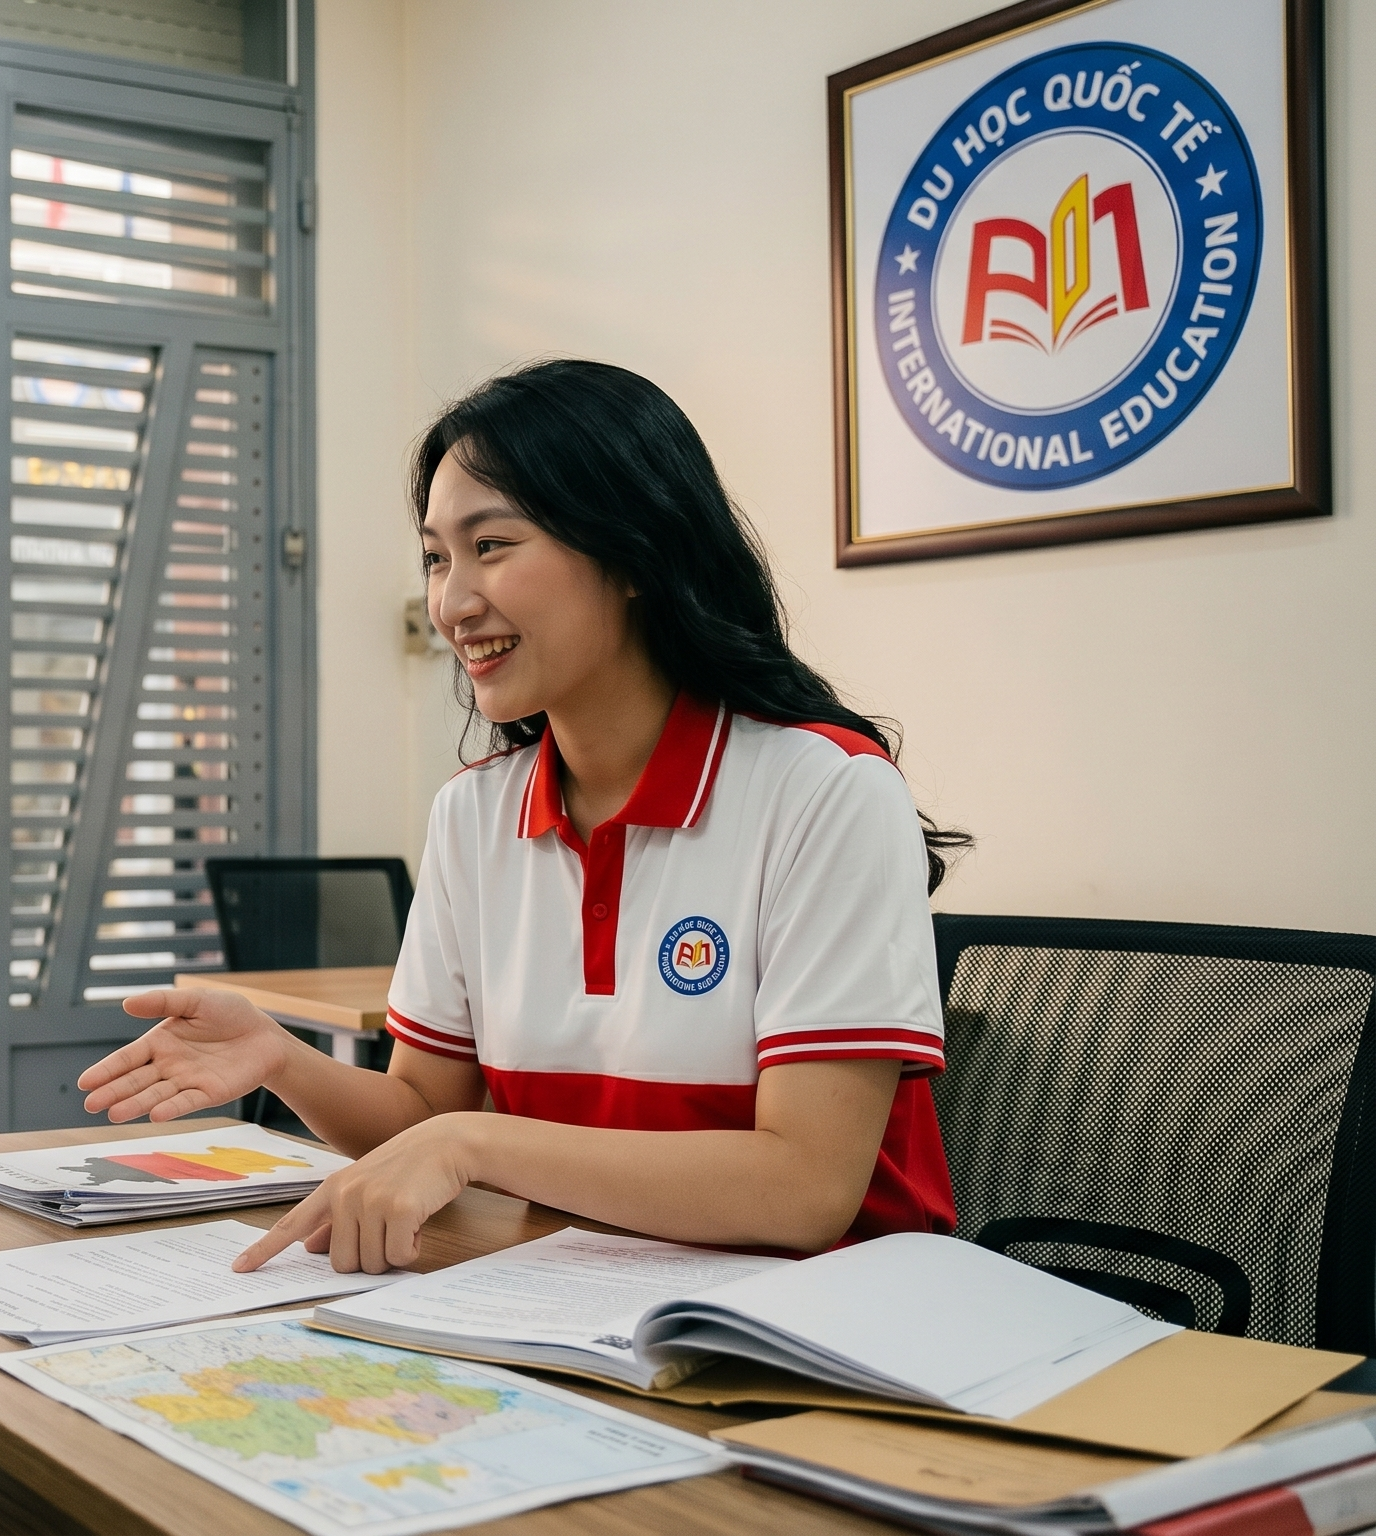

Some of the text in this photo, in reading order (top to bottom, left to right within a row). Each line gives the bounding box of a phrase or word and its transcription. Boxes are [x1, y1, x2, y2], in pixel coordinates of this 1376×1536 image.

[907, 61, 1223, 231] DU HỌC QUỐC TẾ
[888, 211, 1239, 471] INTERNATIONAL EDUCATION
